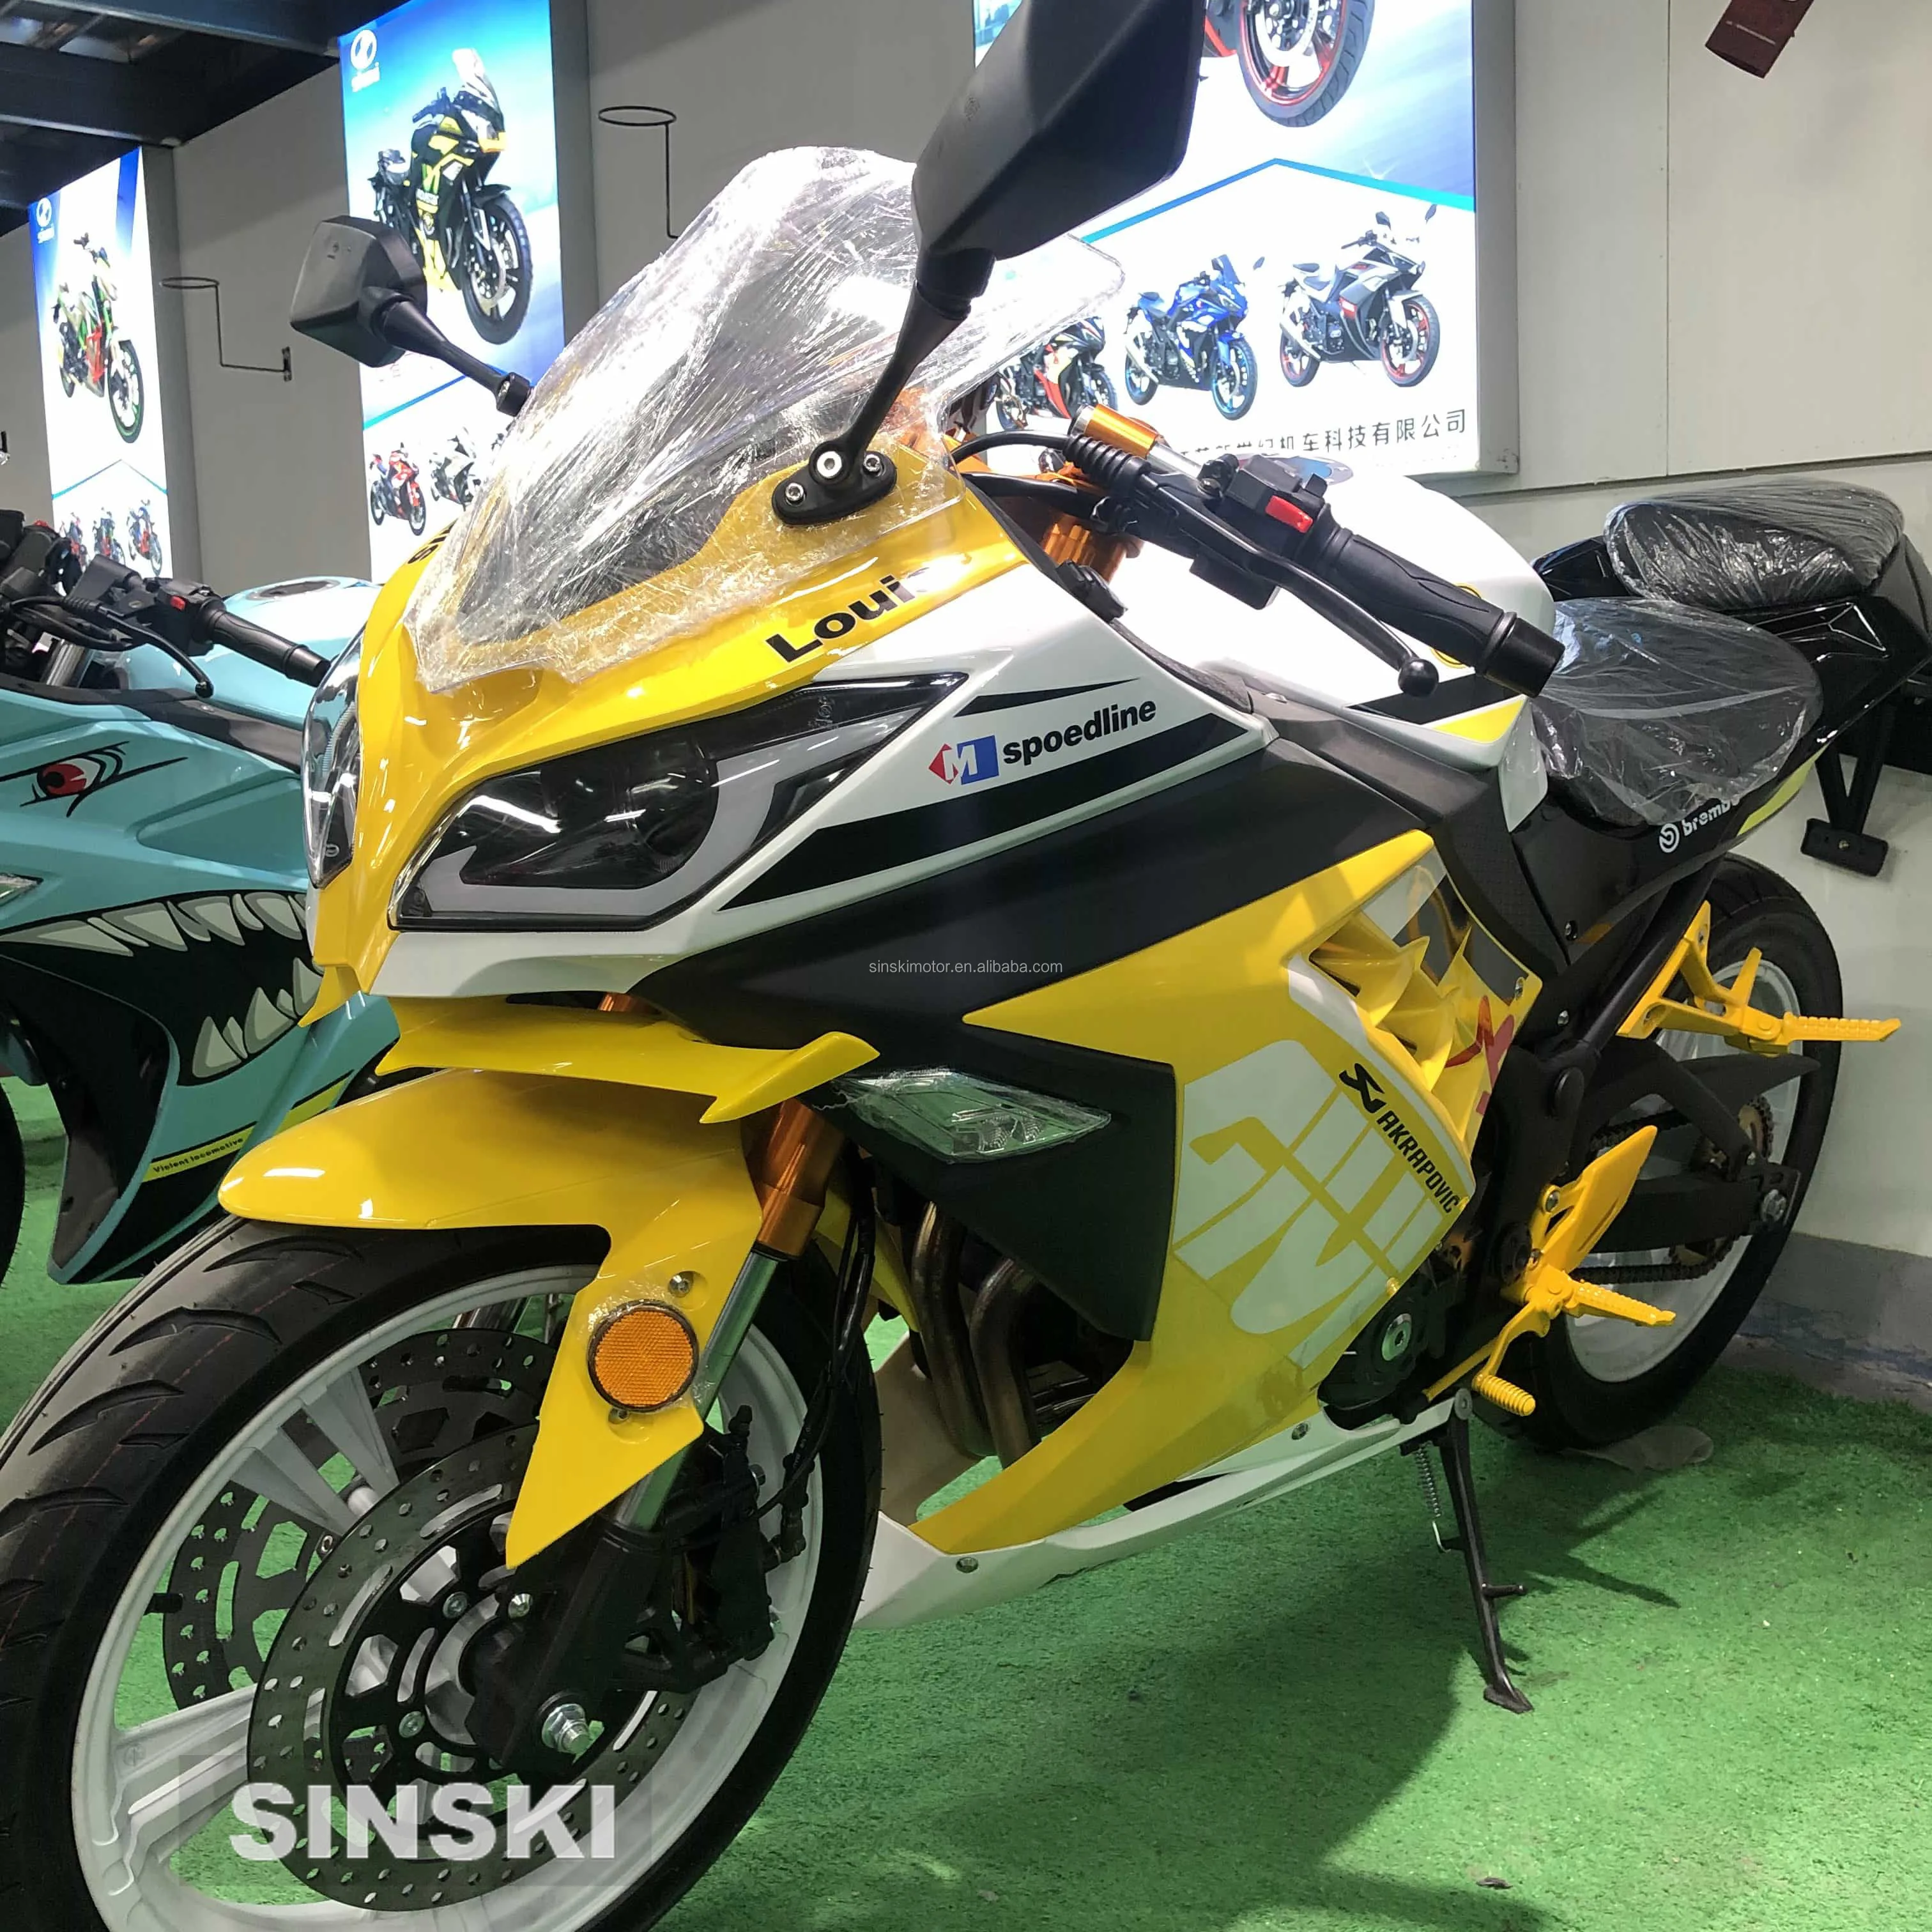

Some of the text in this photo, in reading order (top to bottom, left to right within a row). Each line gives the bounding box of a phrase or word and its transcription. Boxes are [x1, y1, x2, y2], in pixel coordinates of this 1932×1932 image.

[1180, 409, 1465, 456] 纪机车科技有限公司
[765, 566, 930, 663] Loui
[1003, 700, 1156, 766] spoedline
[1376, 1110, 1460, 1213] AKRAPOVIC
